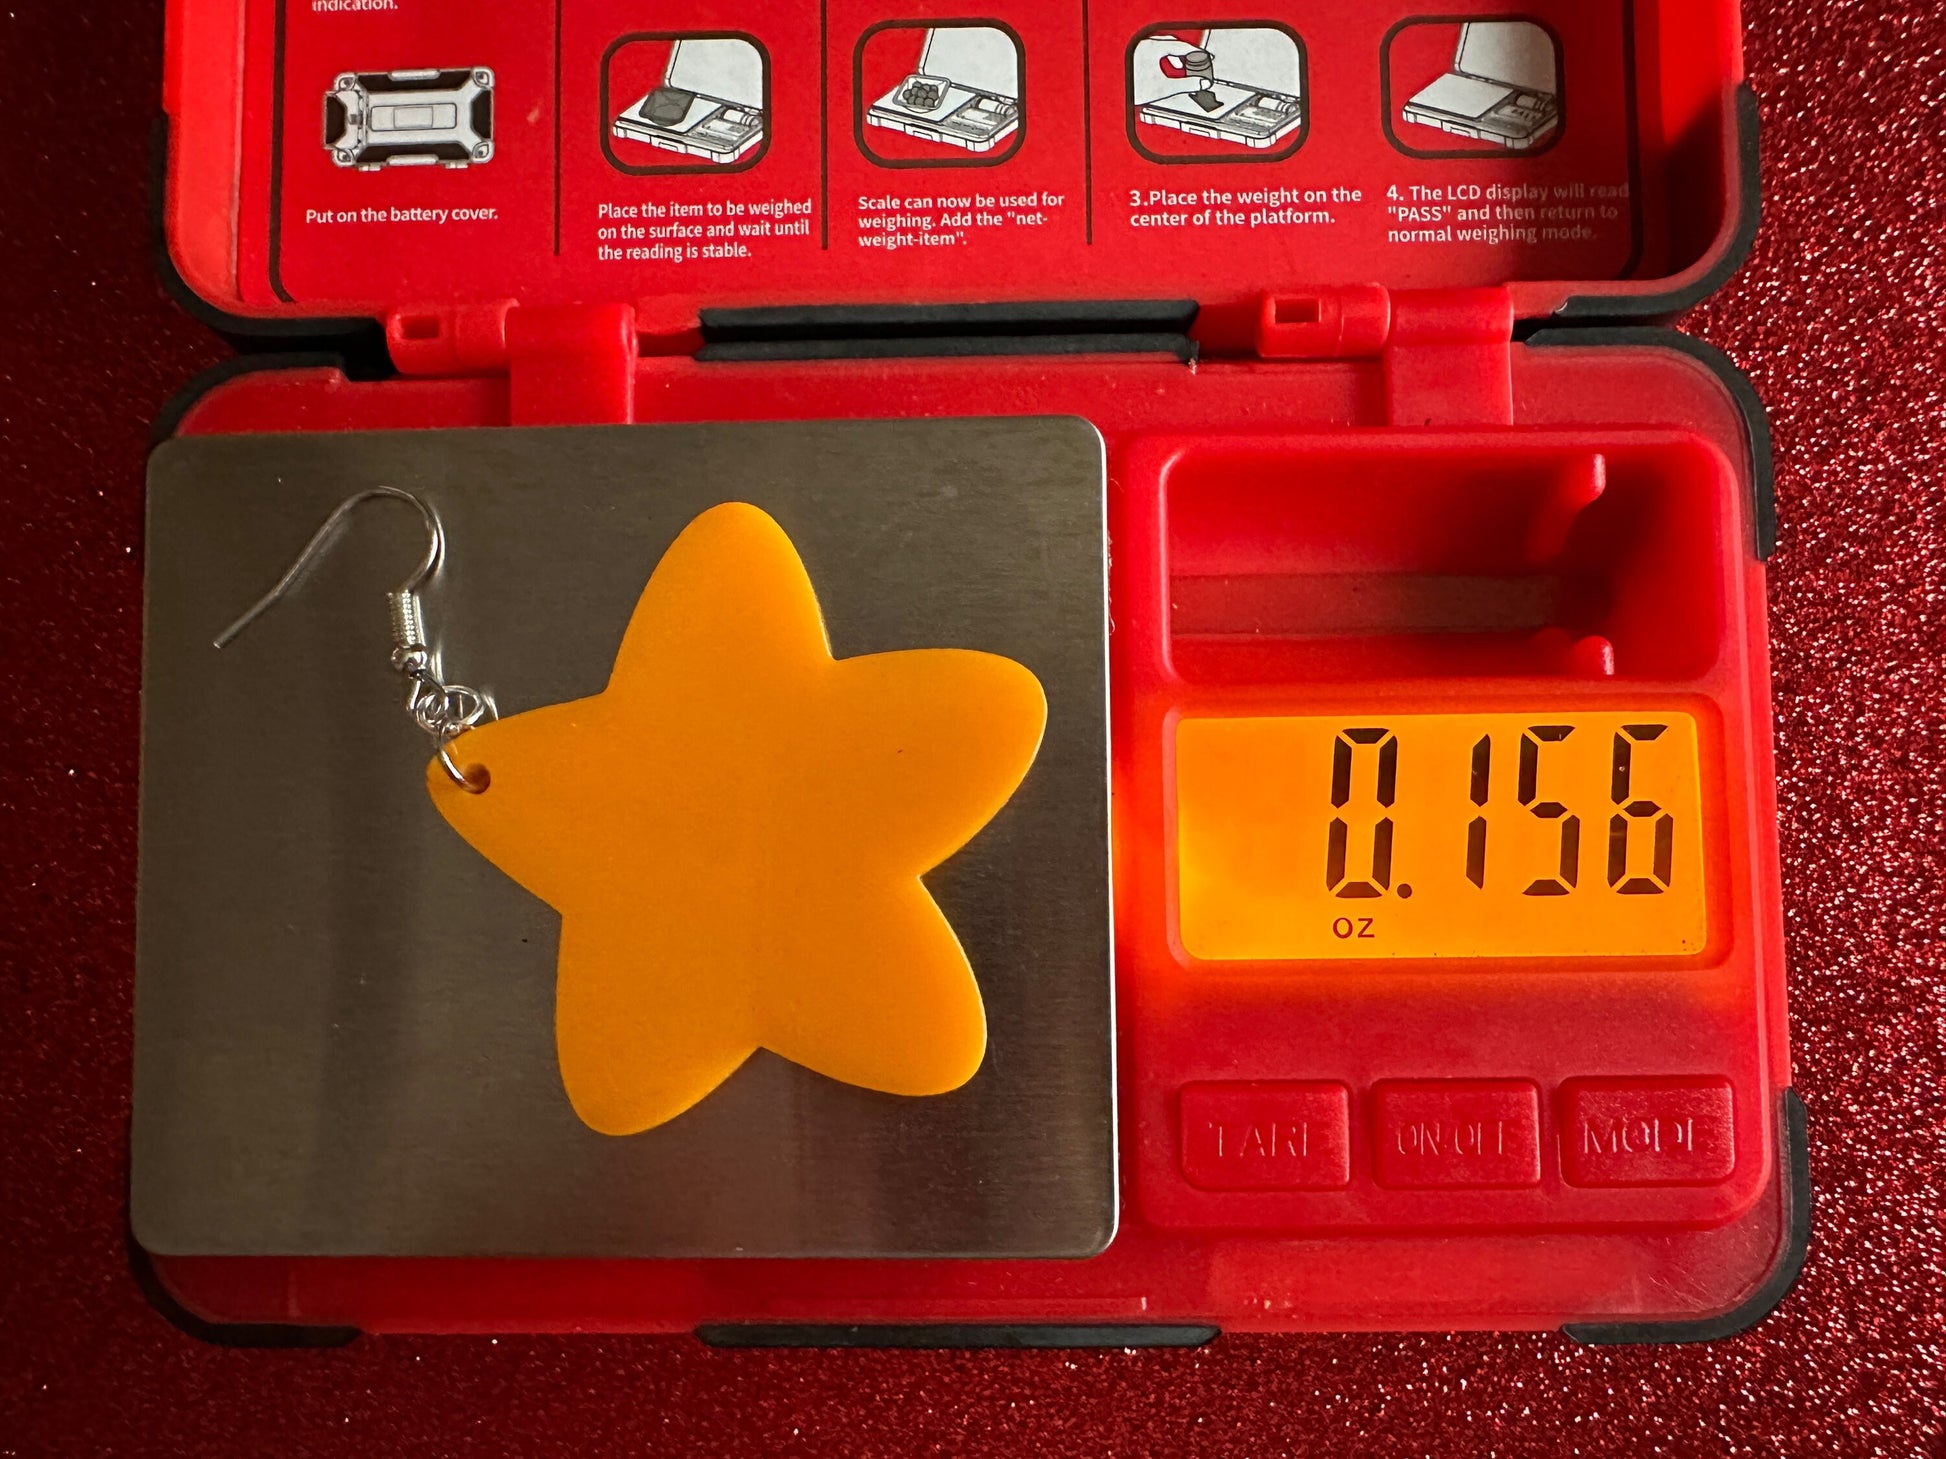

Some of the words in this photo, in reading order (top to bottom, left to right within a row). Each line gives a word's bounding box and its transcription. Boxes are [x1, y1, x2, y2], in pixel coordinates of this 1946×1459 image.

[857, 195, 901, 211] Scale
[904, 196, 933, 209] can
[937, 195, 972, 209] now
[975, 193, 996, 208] be
[1000, 192, 1038, 208] used
[1042, 191, 1065, 206] for
[1129, 189, 1198, 207] 3.Place
[1202, 188, 1232, 205] the
[1237, 187, 1300, 208] weight
[1304, 190, 1327, 203] on
[1331, 186, 1362, 203] the
[1386, 185, 1405, 201] 4.
[1409, 186, 1443, 201] The
[1447, 185, 1481, 201] LCD
[1485, 183, 1548, 203] display
[1553, 183, 1585, 199] will
[1589, 182, 1630, 198] read
[305, 207, 334, 224] Put
[336, 210, 357, 224] on
[360, 207, 388, 224] the
[390, 205, 449, 226] battery
[451, 206, 499, 222] cover.
[598, 202, 638, 219] Place
[641, 202, 667, 218] the
[669, 201, 704, 217] item
[706, 201, 723, 217] to
[726, 199, 745, 216] be
[748, 197, 812, 219] weighed
[1130, 212, 1189, 228] center
[1193, 209, 1212, 226] of
[1216, 209, 1246, 226] the
[1250, 206, 1336, 229] platform.
[1387, 205, 1452, 223] "PASS"
[1457, 204, 1490, 221] and
[1495, 203, 1536, 221] then
[1539, 206, 1596, 220] return
[1601, 205, 1619, 220] to
[597, 226, 617, 240] on
[620, 223, 646, 240] the
[649, 221, 703, 239] surface
[706, 219, 735, 238] and
[738, 219, 771, 237] wait
[774, 218, 810, 236] until
[858, 212, 937, 232] weighing.
[940, 211, 972, 227] Add
[975, 212, 1003, 226] the
[1007, 211, 1048, 226] "net-
[858, 231, 968, 251] weight-item".
[1388, 225, 1452, 243] normal
[1456, 223, 1538, 245] weighing
[1541, 223, 1599, 242] mode.
[598, 243, 623, 261] the
[626, 243, 683, 264] reading
[686, 241, 699, 259] is
[702, 241, 752, 259] stable.
[1326, 724, 1674, 898] 0.156
